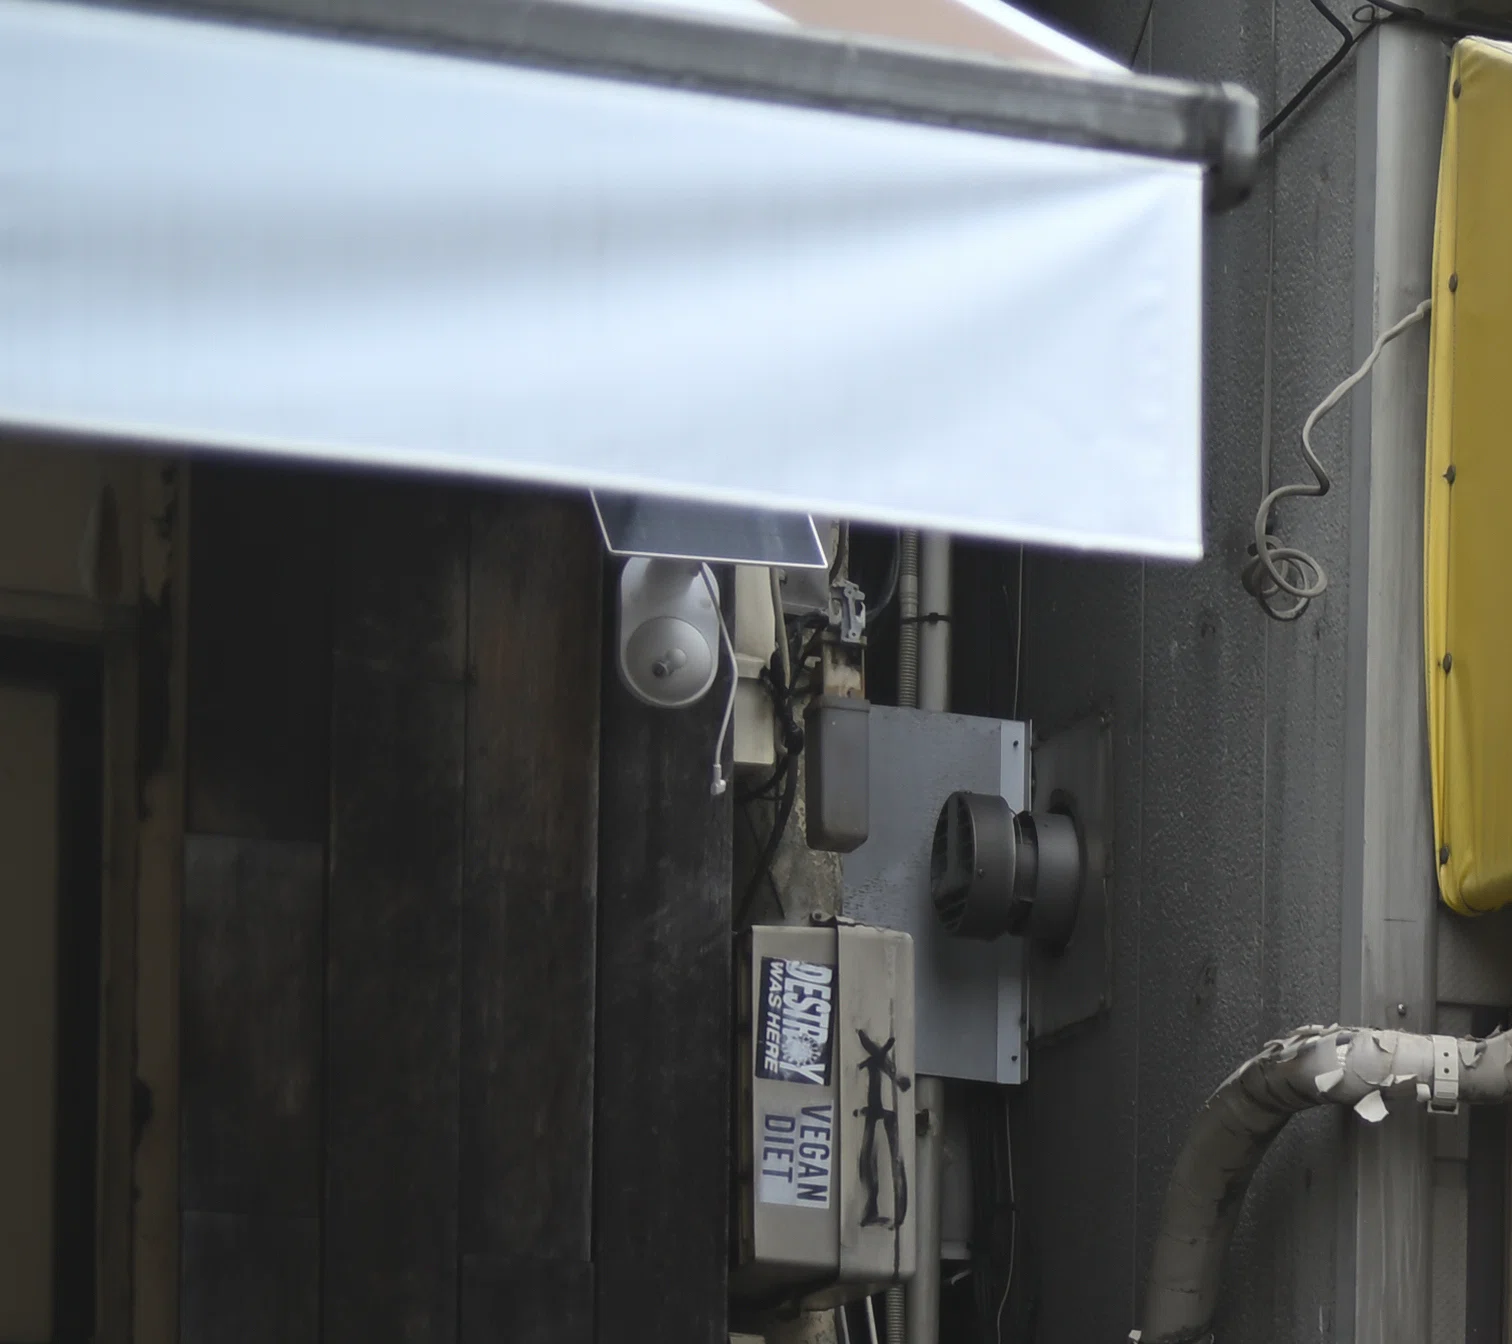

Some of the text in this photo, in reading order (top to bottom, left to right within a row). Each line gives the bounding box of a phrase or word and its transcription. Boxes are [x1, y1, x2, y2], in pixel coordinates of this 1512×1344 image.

[763, 961, 785, 1074] WAS HERE
[762, 1113, 796, 1184] DIET
[796, 1104, 832, 1203] VEGAN
